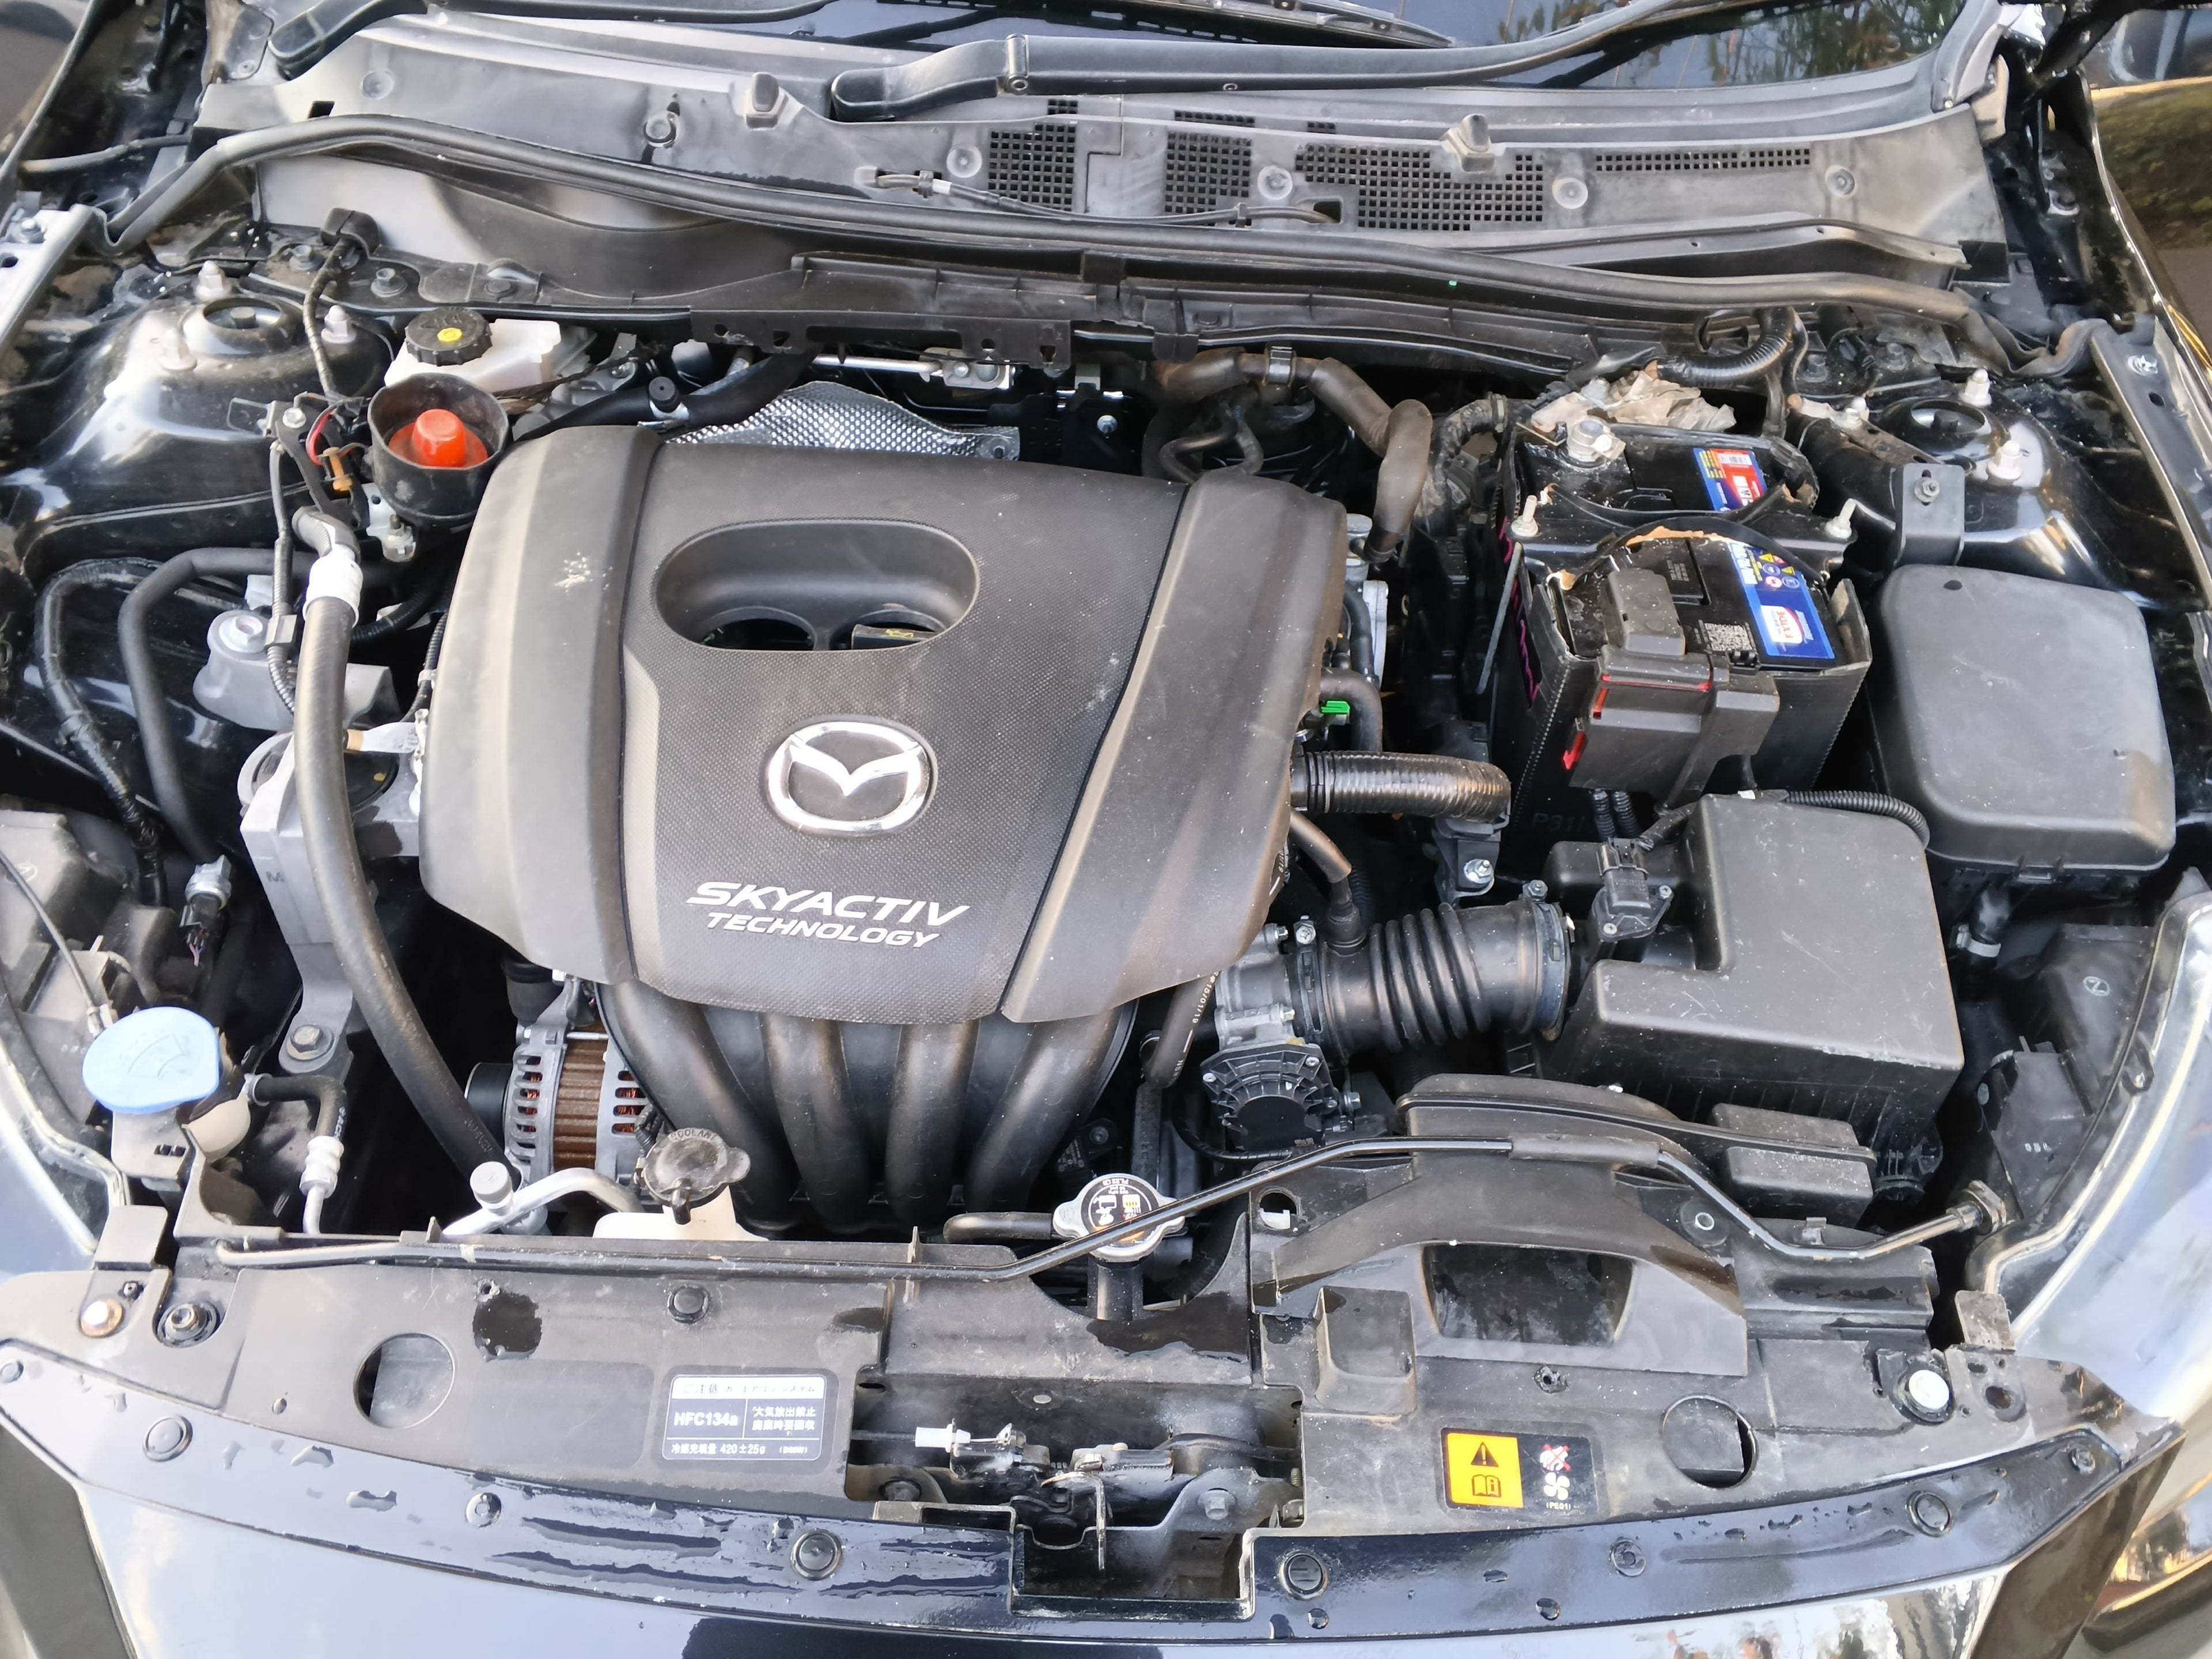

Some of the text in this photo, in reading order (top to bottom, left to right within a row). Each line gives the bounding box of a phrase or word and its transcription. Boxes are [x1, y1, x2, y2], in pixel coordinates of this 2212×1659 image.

[686, 881, 971, 926] SKYACTIV
[706, 912, 941, 948] TECHNOLOGY
[674, 1412, 739, 1426] HFC134a
